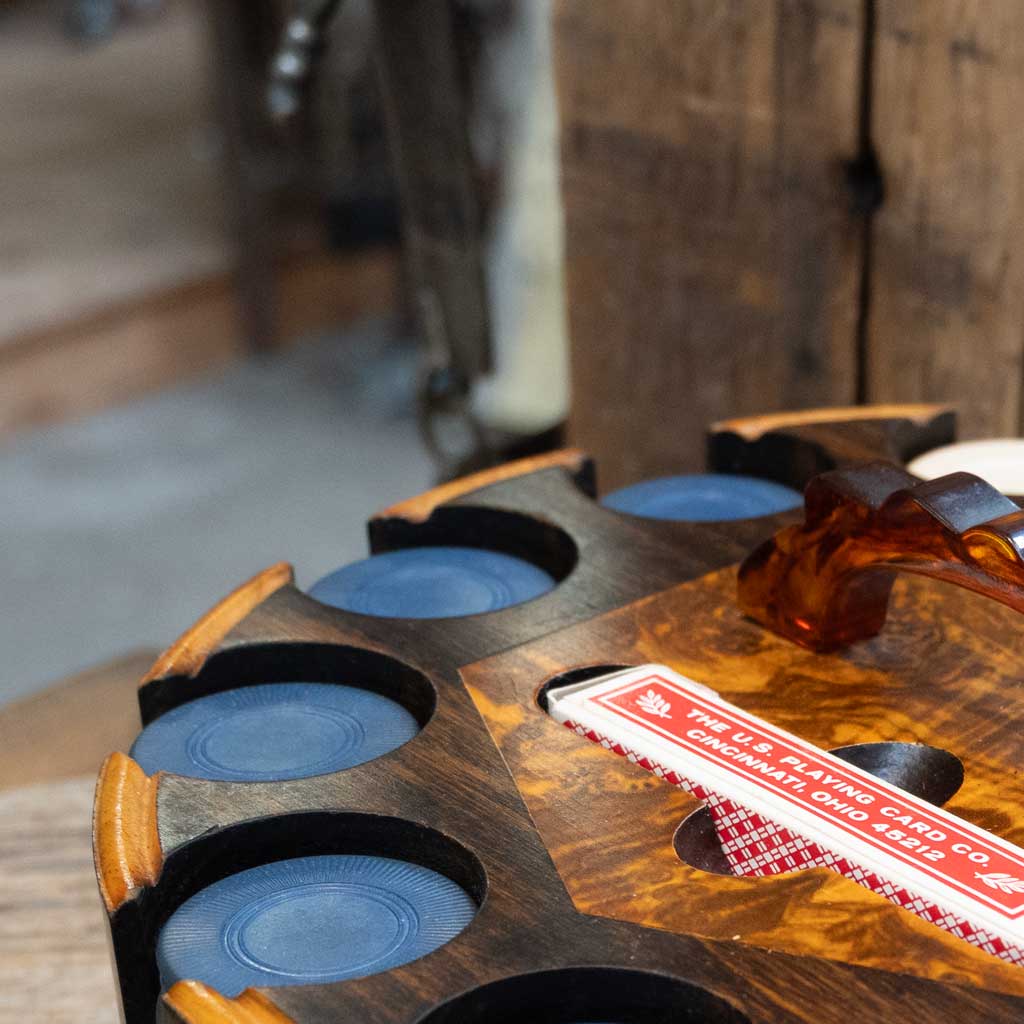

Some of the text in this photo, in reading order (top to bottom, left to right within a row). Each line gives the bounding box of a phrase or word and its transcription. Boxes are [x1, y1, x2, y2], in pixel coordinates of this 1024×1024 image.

[686, 708, 990, 867] THE U.S. PLAYING CARD CO.
[686, 729, 946, 862] CINCINNATI, OHIO 45212
